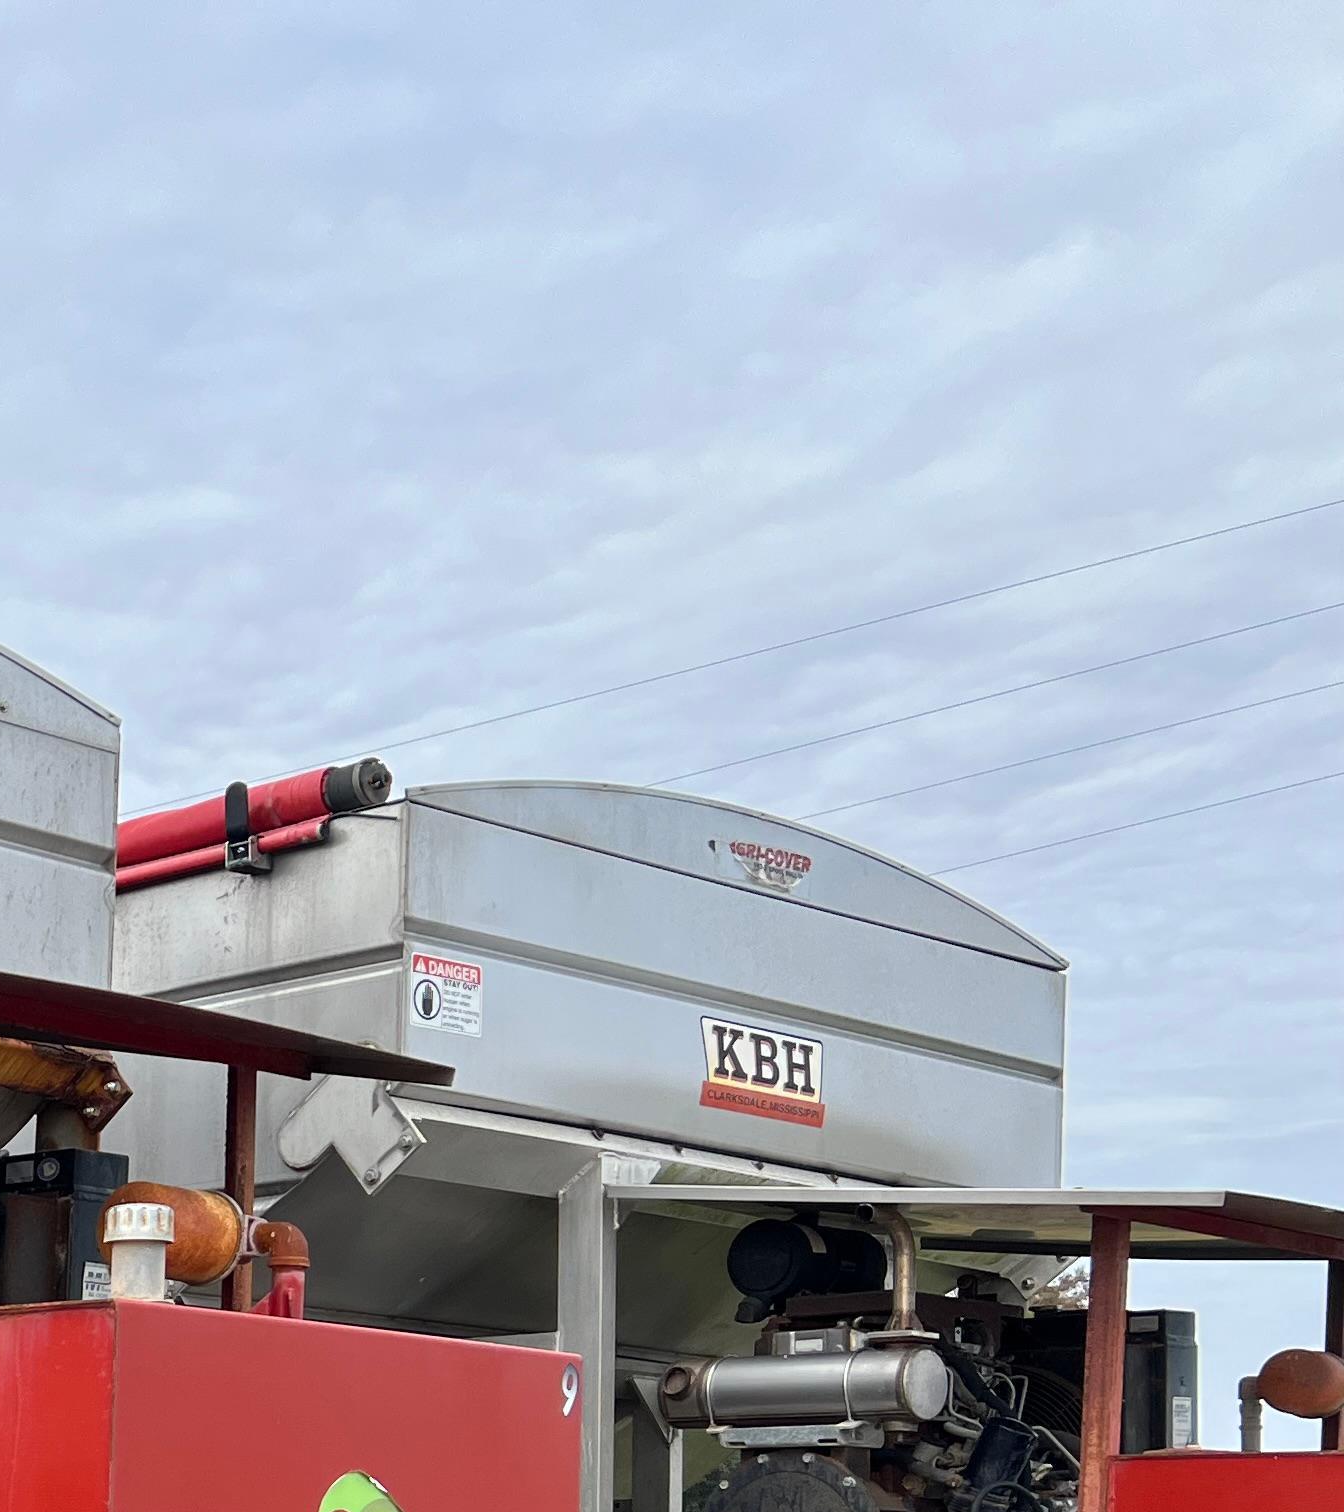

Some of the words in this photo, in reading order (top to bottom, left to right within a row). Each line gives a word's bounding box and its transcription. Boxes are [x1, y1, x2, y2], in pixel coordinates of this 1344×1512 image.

[428, 960, 479, 984] DANGER
[444, 979, 461, 988] STAY
[712, 1024, 816, 1098] KBH
[561, 1362, 579, 1417] 9
